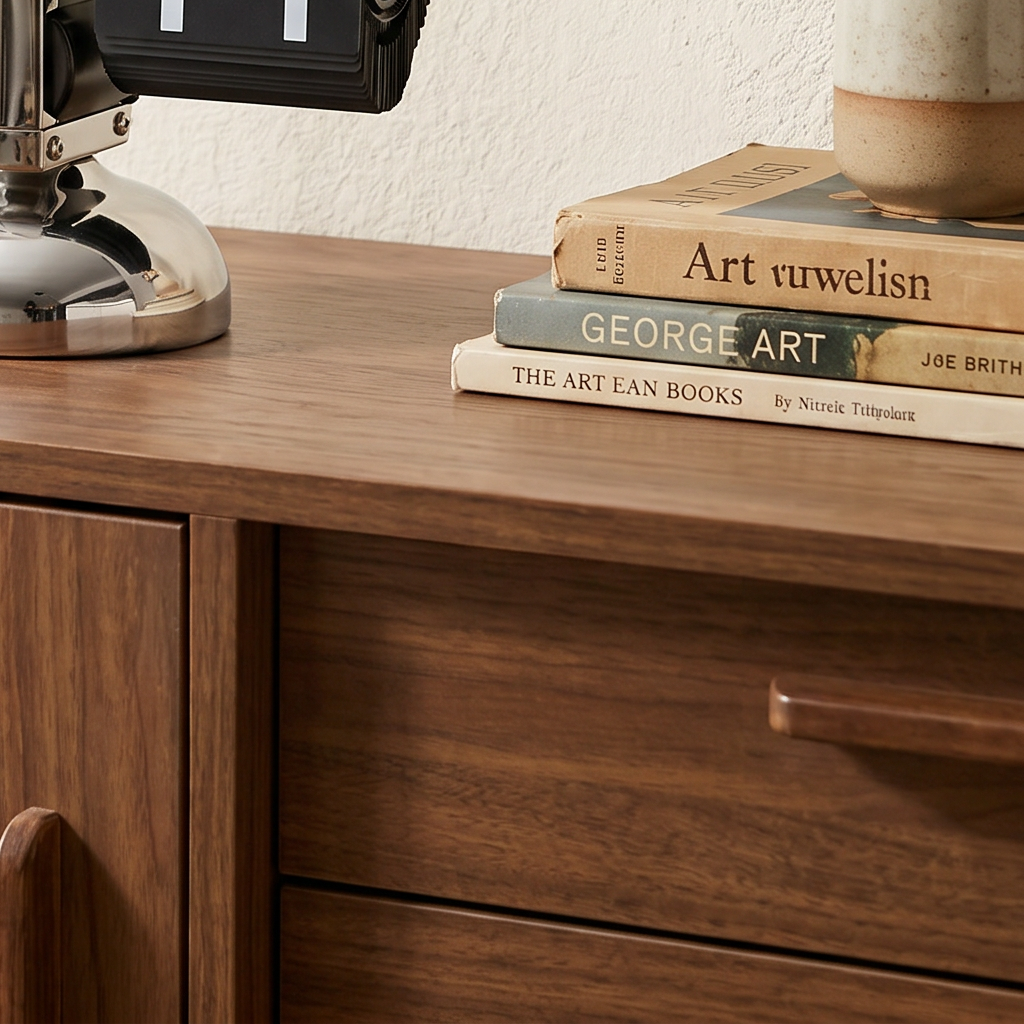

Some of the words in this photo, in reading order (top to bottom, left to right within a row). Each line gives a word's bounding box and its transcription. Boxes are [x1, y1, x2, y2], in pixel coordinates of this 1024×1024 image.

[682, 242, 756, 286] Art
[581, 312, 739, 357] GEORGE
[751, 328, 826, 364] ART
[965, 356, 1022, 375] BRITH
[512, 366, 556, 387] THE
[562, 372, 606, 391] ART
[612, 376, 658, 396] EAN
[666, 381, 743, 405] BOOKS
[775, 394, 792, 413] By
